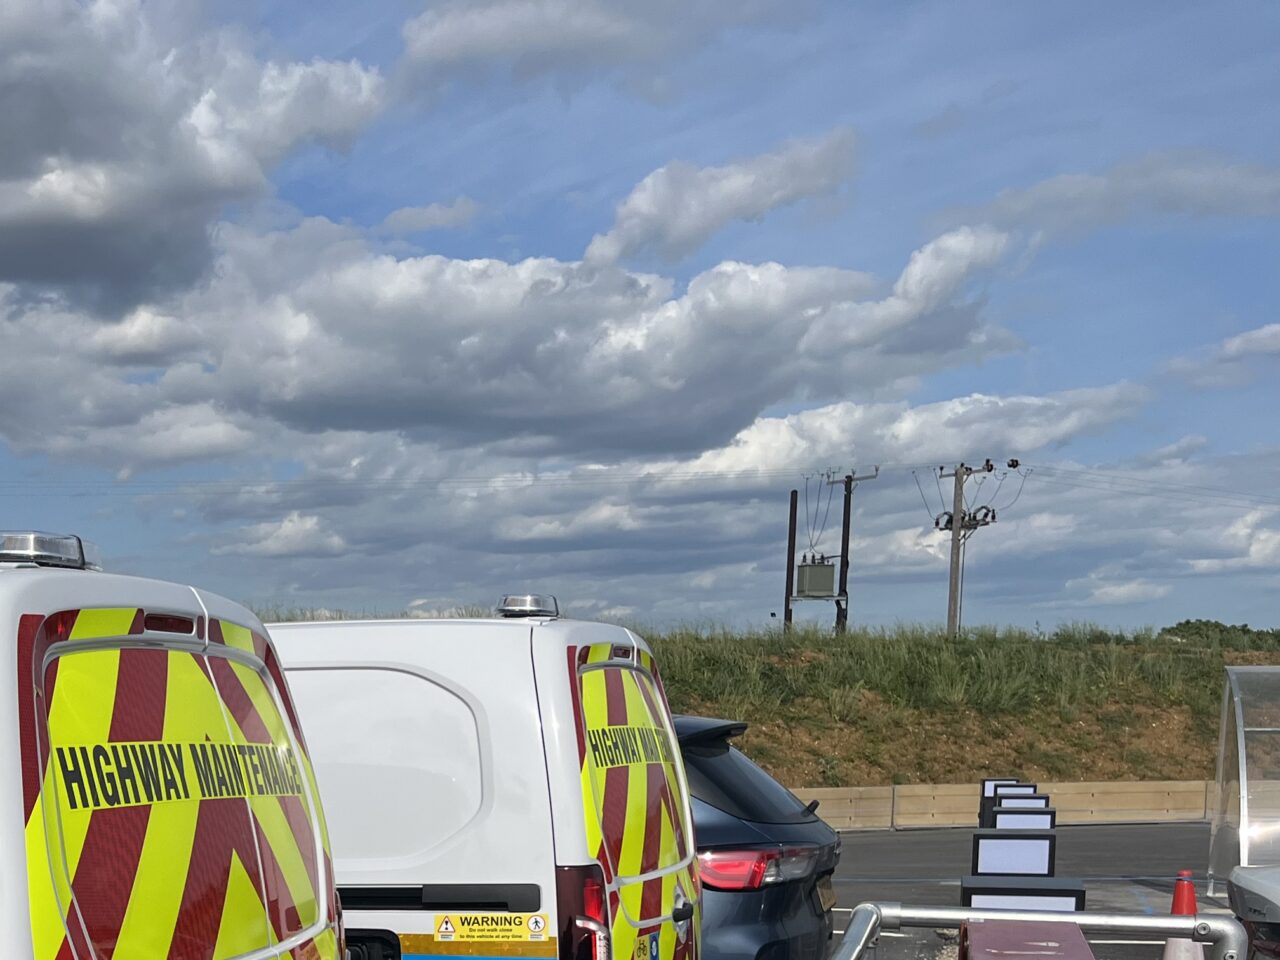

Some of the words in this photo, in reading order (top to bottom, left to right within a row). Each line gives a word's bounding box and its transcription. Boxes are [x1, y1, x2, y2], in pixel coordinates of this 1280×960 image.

[587, 728, 642, 768] HIGHWAY
[56, 743, 190, 810] HIGHWAY
[189, 743, 303, 798] MAINTENANCE
[459, 916, 523, 926] WARNING
